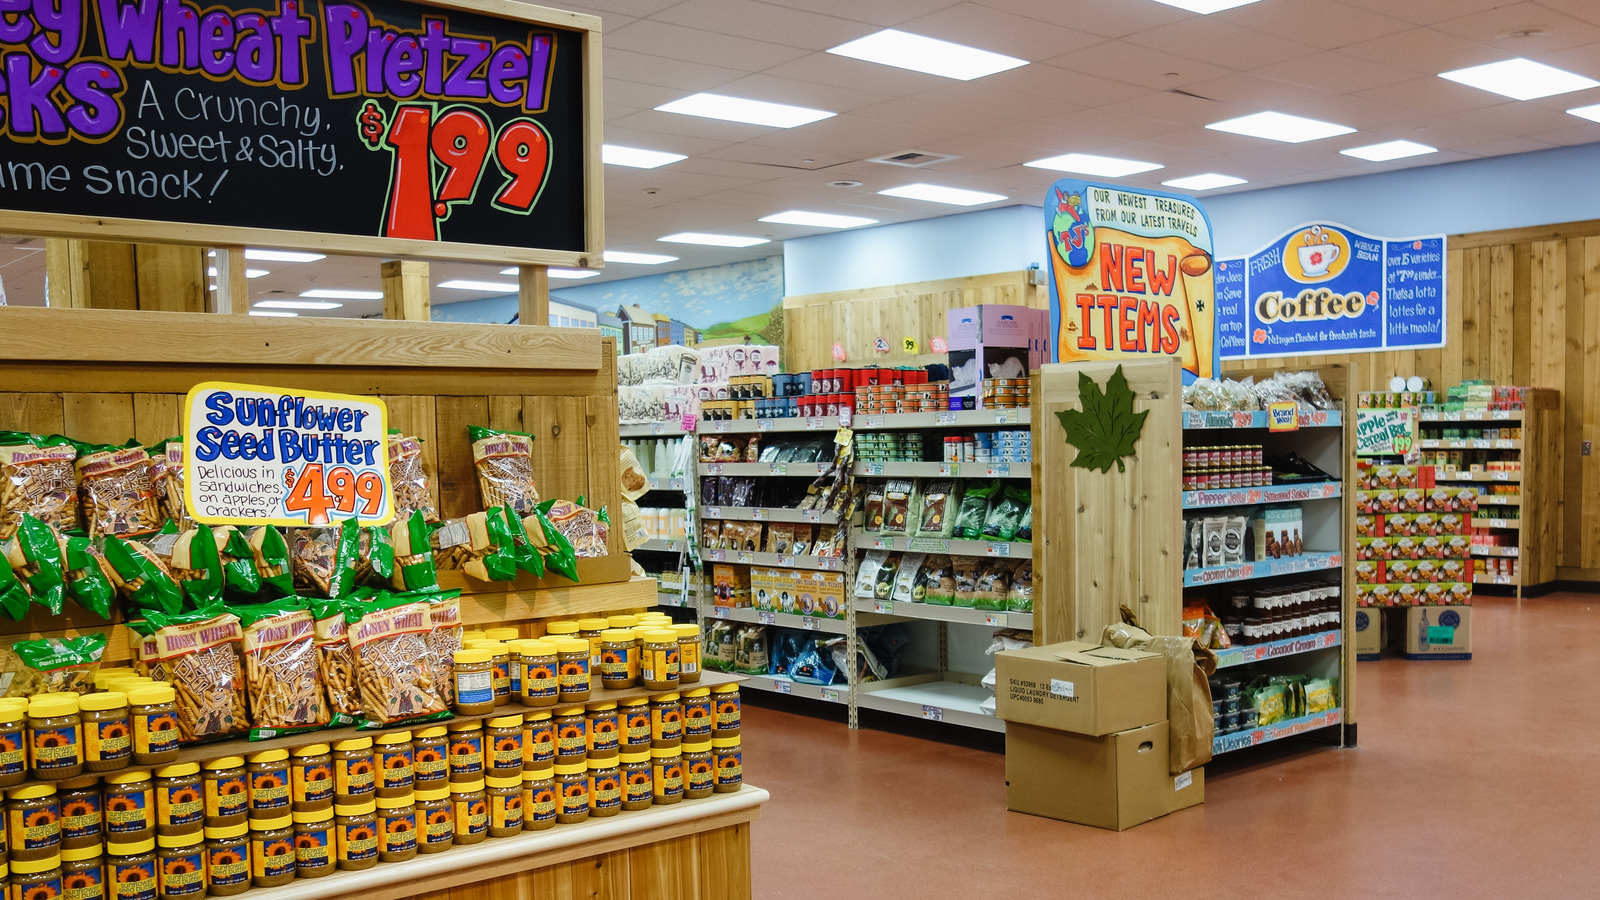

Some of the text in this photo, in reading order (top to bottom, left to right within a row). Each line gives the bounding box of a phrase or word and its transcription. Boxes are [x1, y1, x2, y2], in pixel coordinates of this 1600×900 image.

[100, 0, 311, 85] Wheat
[323, 1, 553, 110] Pretzel
[0, 54, 121, 135] ks
[138, 79, 165, 121] A
[126, 126, 232, 165] Sweet
[234, 136, 254, 162] &
[82, 164, 229, 204] snack!
[1094, 189, 1196, 221] OUR NEWEST TREASURES
[1095, 208, 1198, 238] FROM OUR LATEST TRAVELS
[1354, 239, 1381, 252] WHOLE
[1250, 247, 1281, 277] FRESH
[1356, 250, 1379, 262] BEAN
[1401, 252, 1409, 266] 15
[1099, 241, 1178, 297] NEW
[1388, 271, 1395, 284] at
[1415, 285, 1436, 298] lotta
[1222, 303, 1238, 316] real
[1257, 290, 1363, 321] Coffee
[1415, 303, 1426, 316] for
[1428, 305, 1435, 316] a
[1075, 292, 1181, 356] ITEMS
[1220, 320, 1243, 333] on top
[1389, 318, 1440, 335] little moola!
[1220, 335, 1245, 348] Coffees
[1267, 334, 1294, 346] Nitrogen
[1359, 328, 1376, 339] taste
[205, 391, 369, 433] Sunflower
[1272, 408, 1294, 418] Brand
[1388, 422, 1406, 439] Bar
[195, 425, 275, 462] Seed
[278, 428, 381, 466] Butter
[197, 465, 275, 479] Delicious in
[199, 478, 283, 494] sandwiches,
[1291, 487, 1310, 499] Salad
[199, 494, 218, 503] on
[1198, 490, 1227, 506] Pepper
[206, 505, 277, 518] crackers!
[357, 619, 391, 640] HONEY
[392, 612, 424, 630] WHEAT
[165, 631, 198, 652] HONEY
[199, 622, 238, 645] WHEAT
[1010, 678, 1020, 686] SKU
[1010, 686, 1025, 695] LIQUID
[1026, 688, 1049, 698] LAUNDRY
